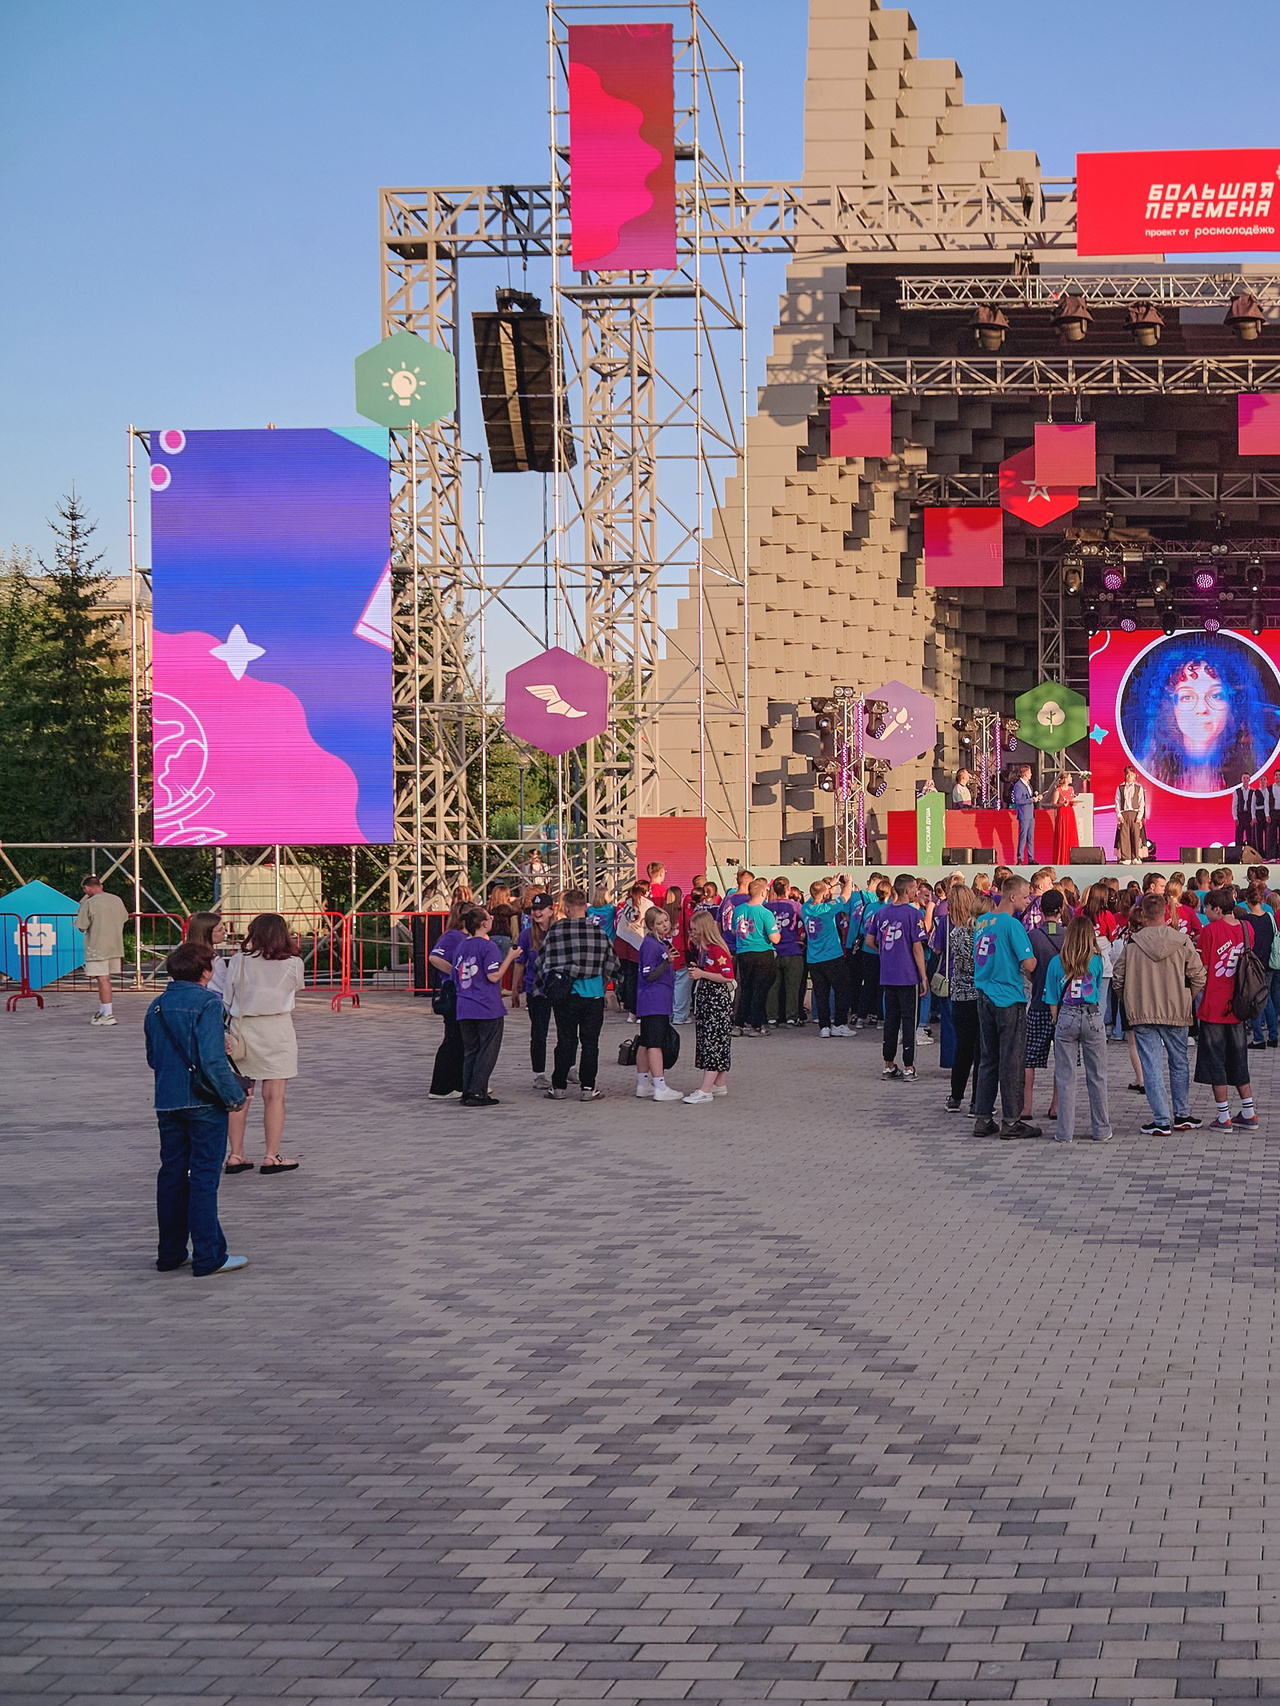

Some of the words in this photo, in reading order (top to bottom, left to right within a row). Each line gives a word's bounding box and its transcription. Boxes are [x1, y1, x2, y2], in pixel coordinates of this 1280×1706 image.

[1147, 182, 1275, 201] БОЛЬШАЯ
[1145, 200, 1271, 219] ПЕРЕМЕНА
[1145, 228, 1177, 238] проект
[1178, 228, 1190, 236] от
[1194, 225, 1276, 239] росмолодёжь
[808, 920, 815, 933] 5
[886, 926, 895, 942] 5
[979, 936, 990, 956] 5
[1227, 947, 1240, 967] 5
[462, 962, 471, 980] 5
[1071, 979, 1082, 999] 5
